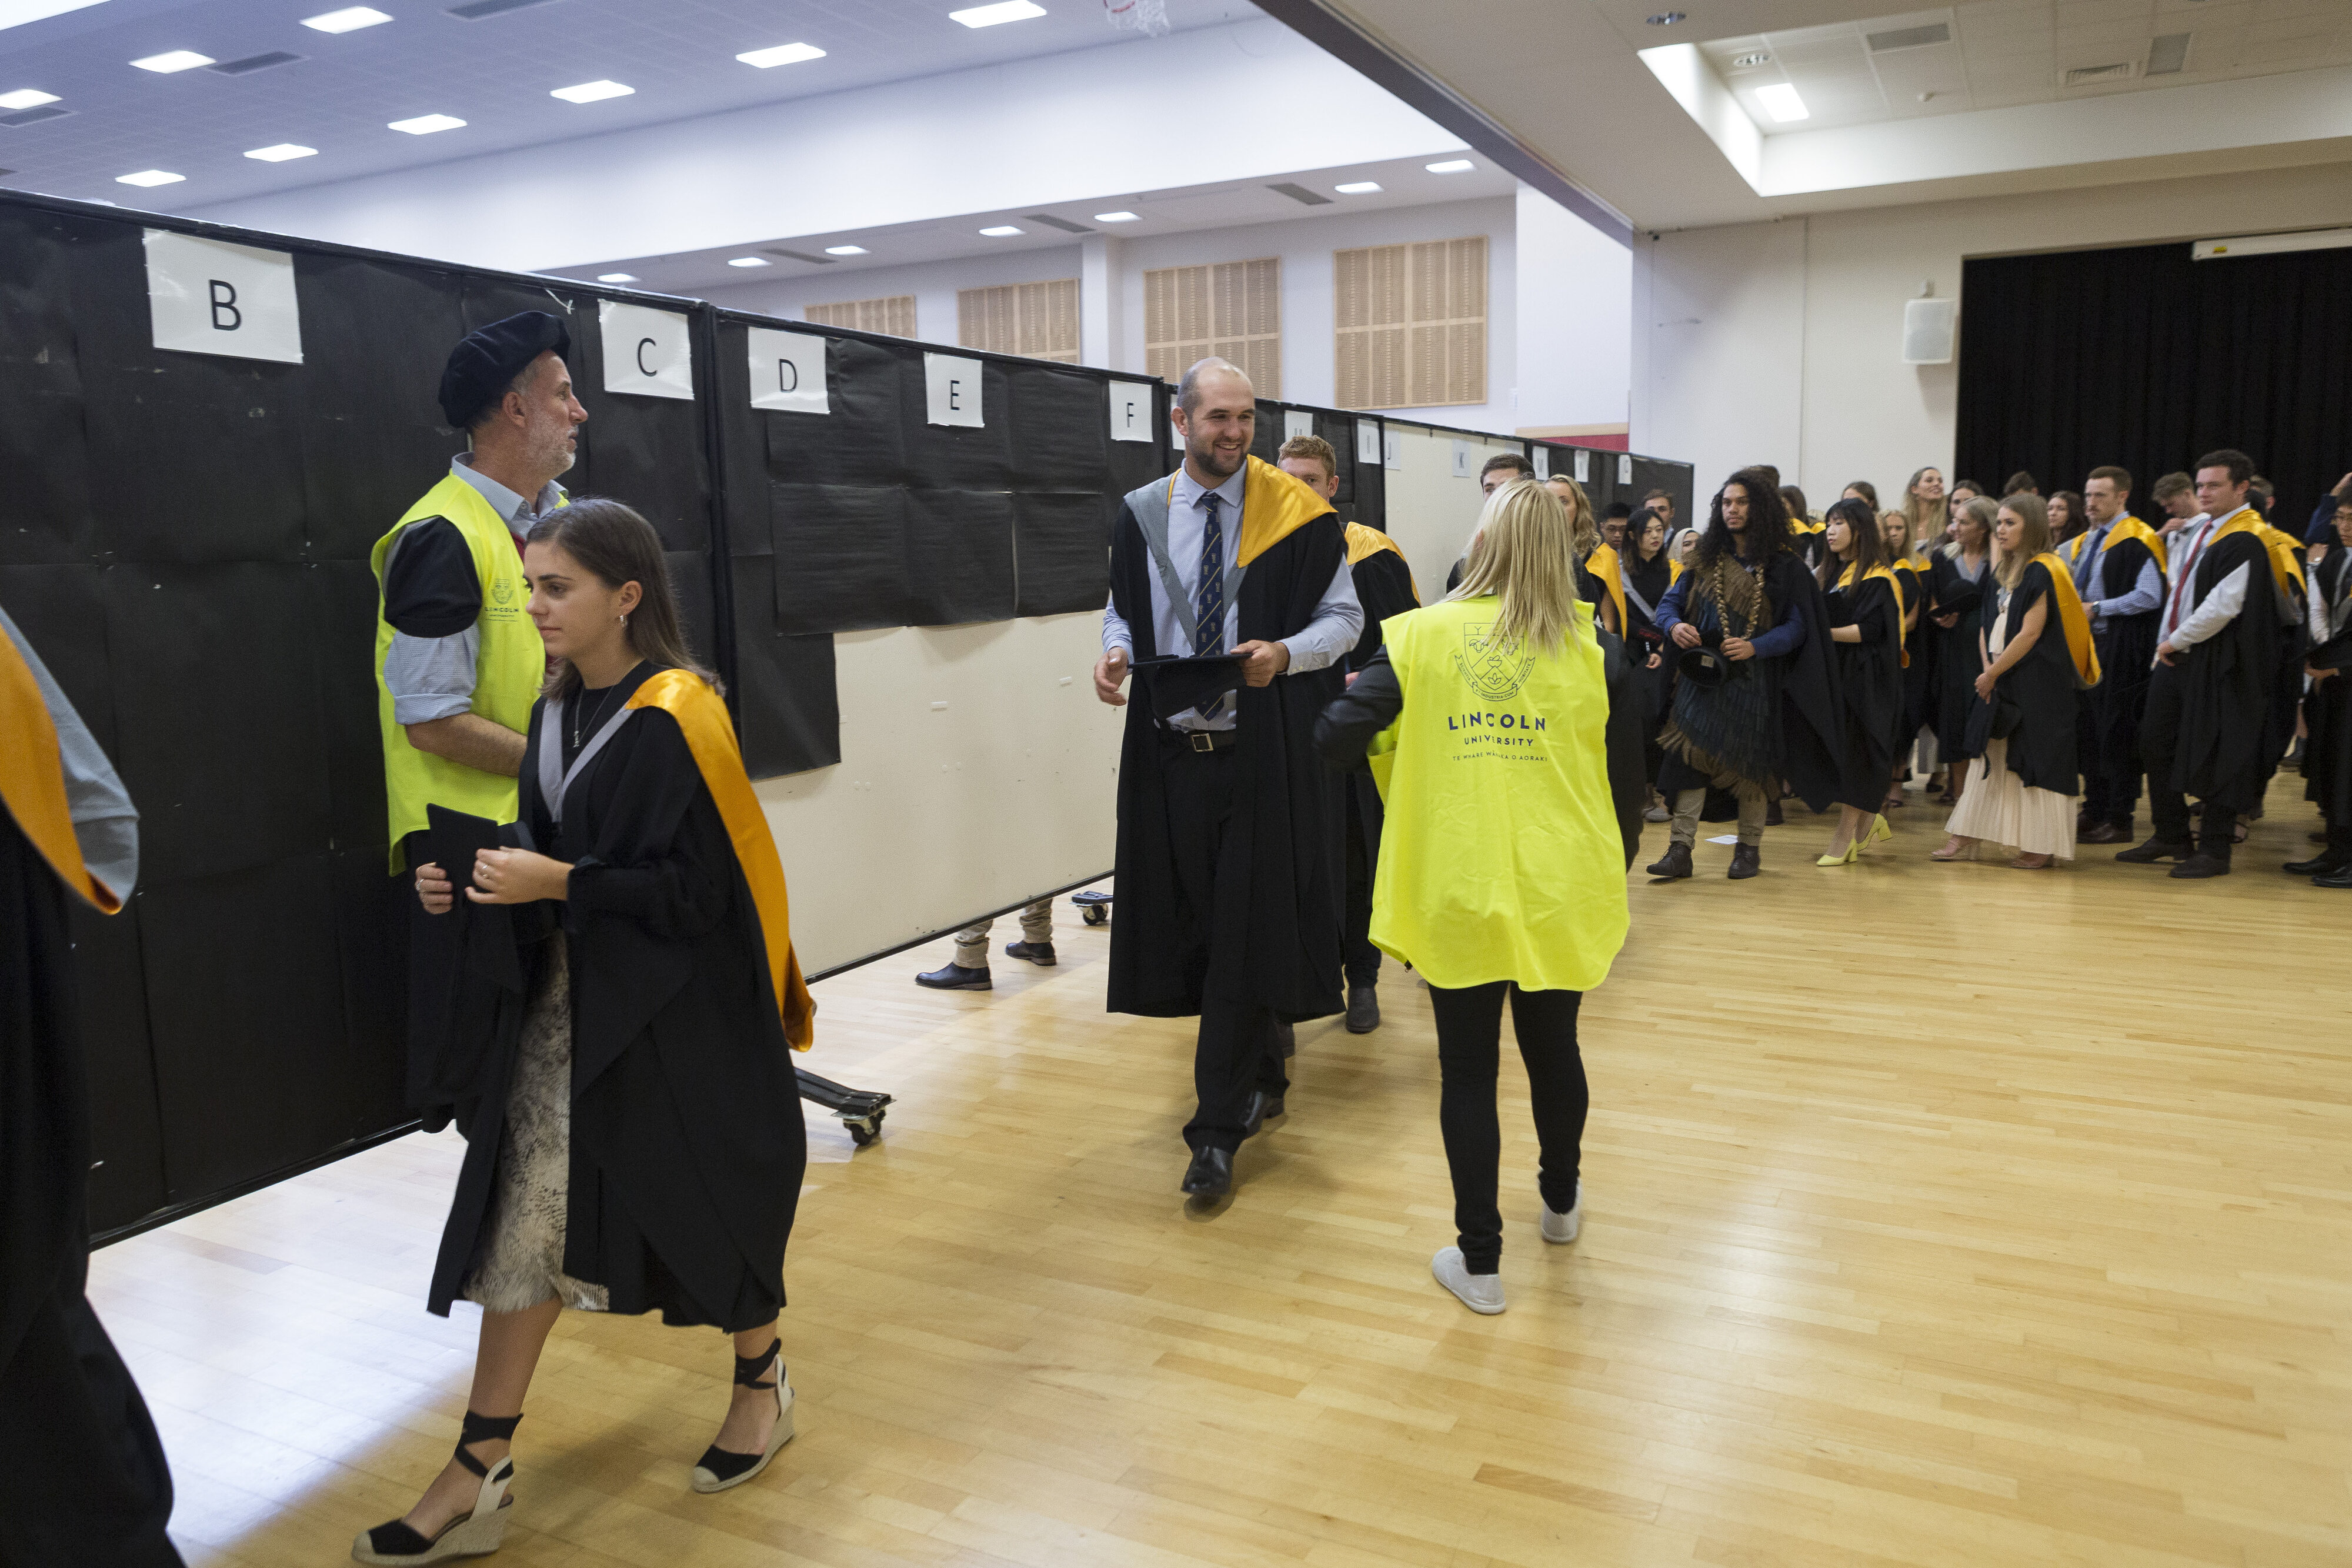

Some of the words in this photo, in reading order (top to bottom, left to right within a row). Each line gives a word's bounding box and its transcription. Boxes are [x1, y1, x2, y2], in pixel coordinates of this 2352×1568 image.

[209, 279, 242, 331] B
[637, 337, 658, 377] C
[778, 358, 798, 392] D
[950, 379, 960, 411] E
[1126, 402, 1135, 428] F
[1448, 712, 1546, 731] LINCOLN
